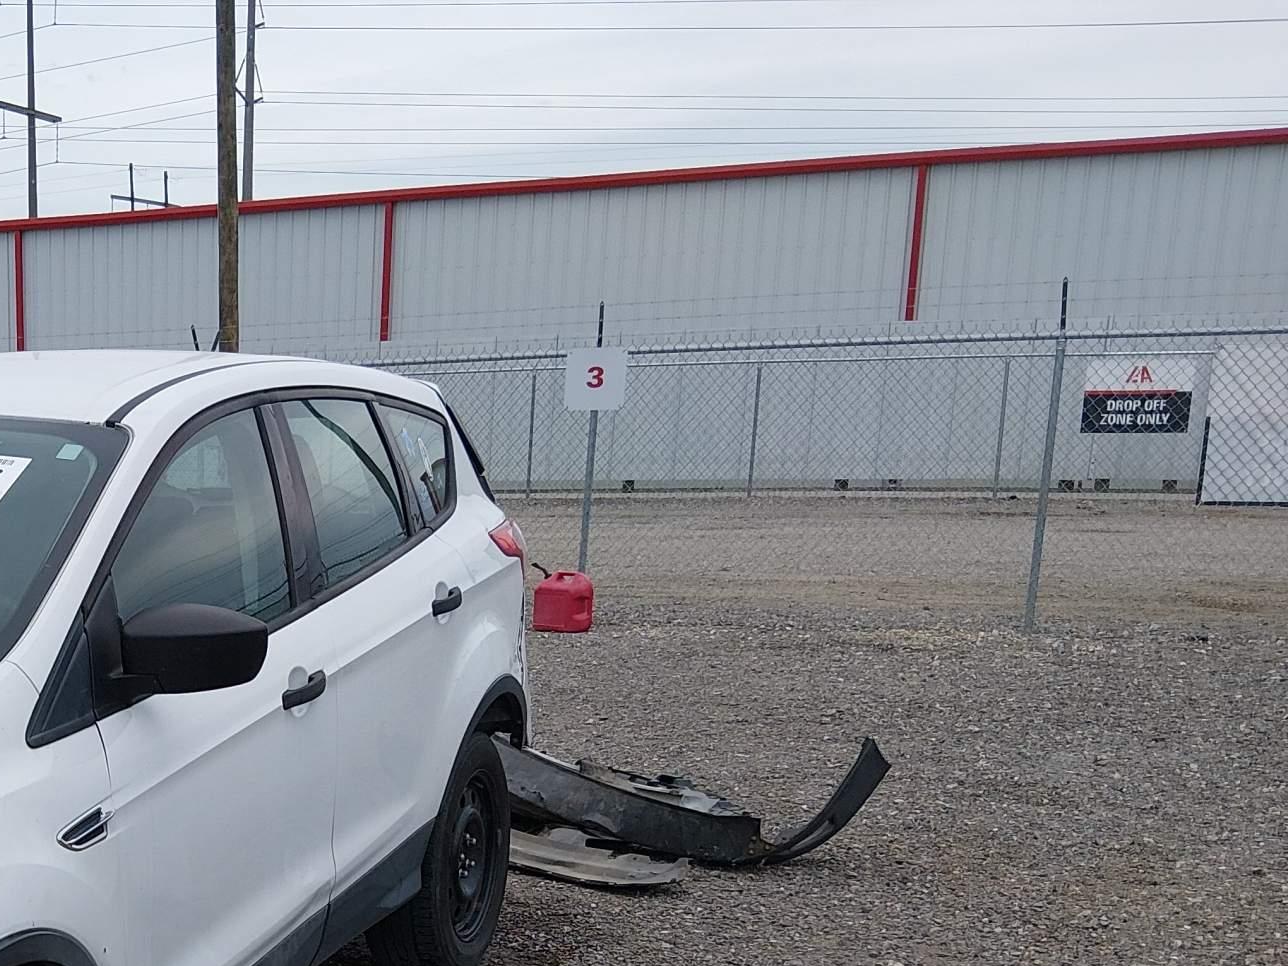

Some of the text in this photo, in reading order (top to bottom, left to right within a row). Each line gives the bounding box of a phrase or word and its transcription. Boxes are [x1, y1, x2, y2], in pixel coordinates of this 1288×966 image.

[586, 366, 604, 388] 3
[1106, 399, 1167, 411] DROP OFF
[1099, 413, 1170, 425] ZONE ONLY
